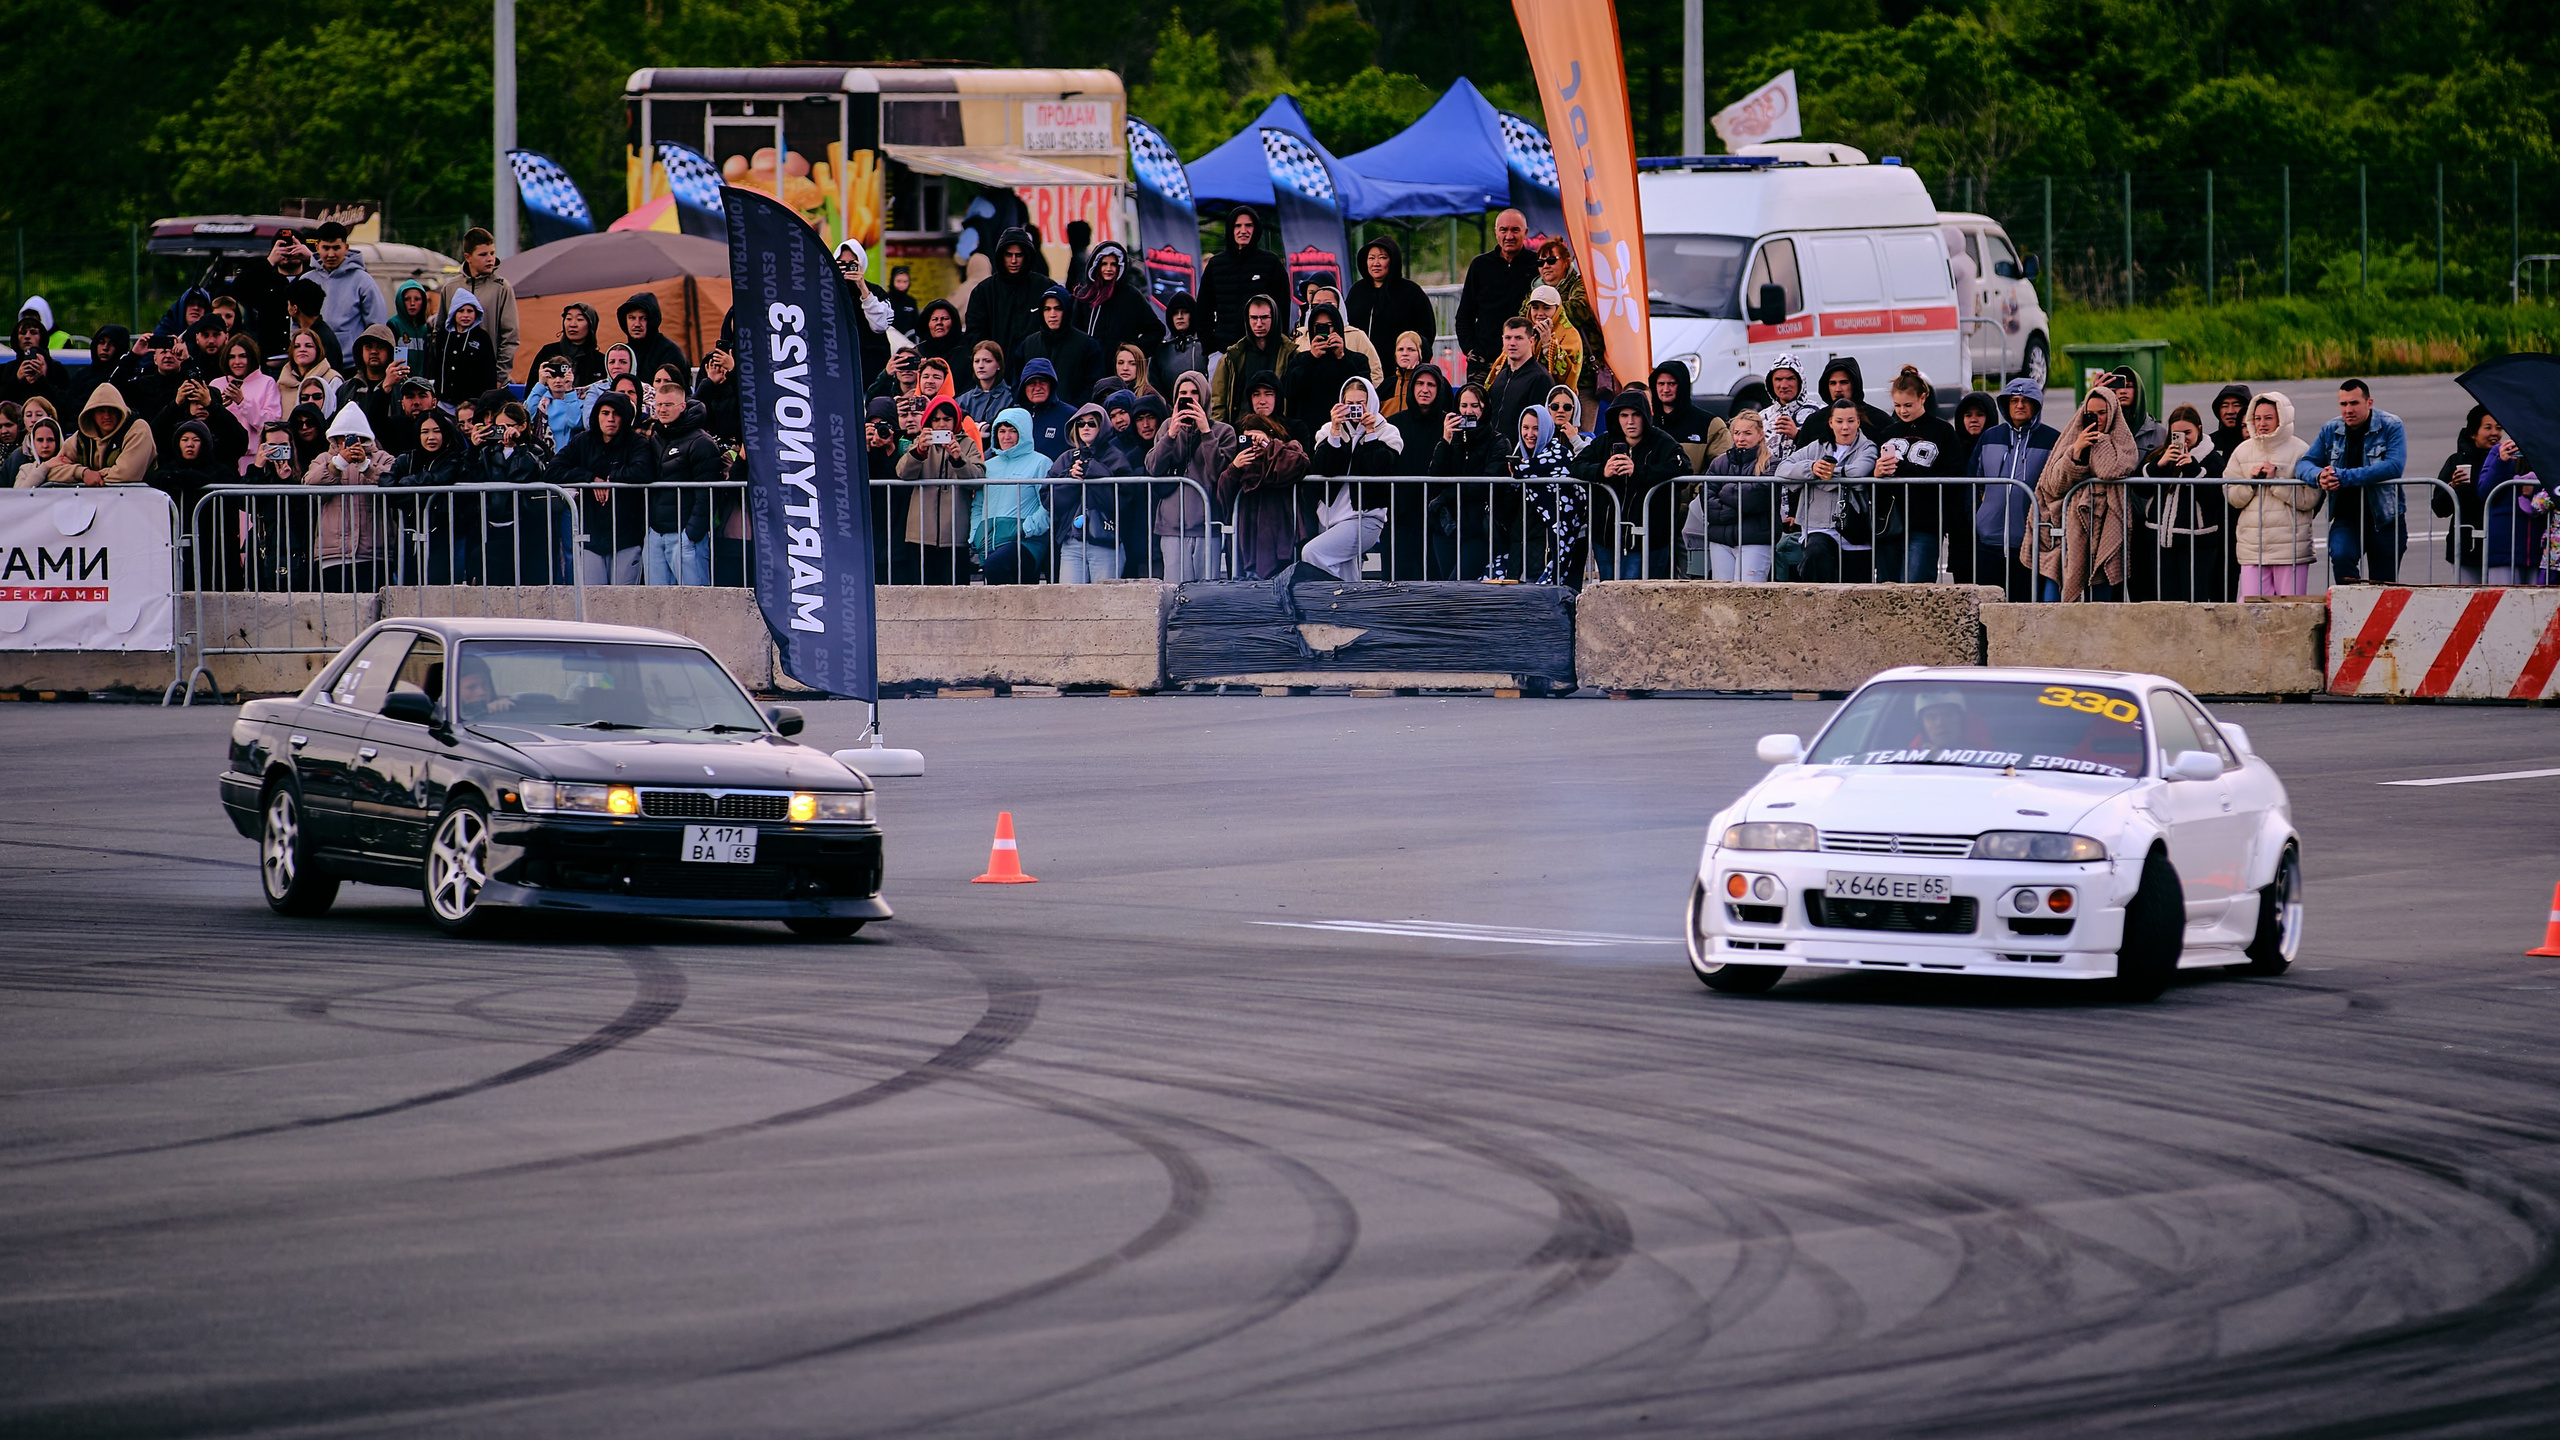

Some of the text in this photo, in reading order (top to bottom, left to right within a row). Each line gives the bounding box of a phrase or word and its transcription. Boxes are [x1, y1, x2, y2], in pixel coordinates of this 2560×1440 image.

[1036, 104, 1097, 127] ПРОДАМ
[1777, 314, 1927, 335] СКОРАЯ МЕДИЦИНСКАЯ ПОМОЩЬ
[0, 547, 108, 581] АМИ
[2037, 686, 2140, 723] 330
[1864, 749, 1931, 765] TEAM
[1937, 749, 2023, 766] MOTOR
[2029, 755, 2127, 778] SPORTS
[716, 828, 743, 843] 171
[735, 847, 751, 859] 65
[1923, 878, 1945, 894] 65
